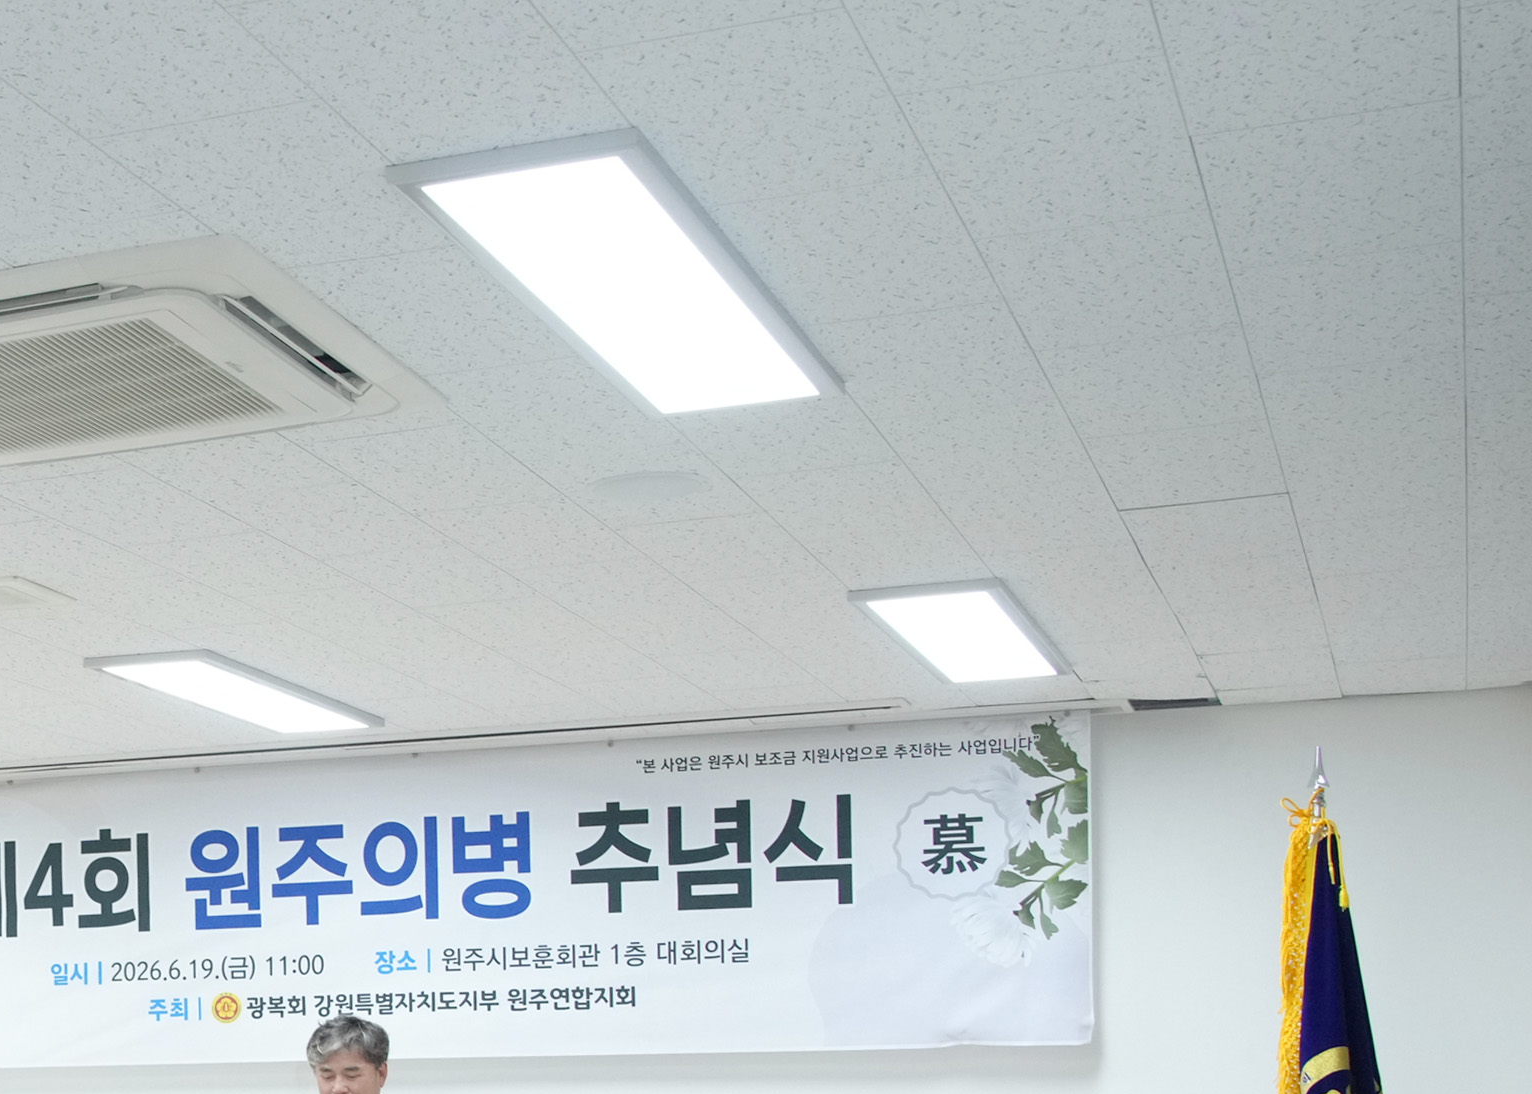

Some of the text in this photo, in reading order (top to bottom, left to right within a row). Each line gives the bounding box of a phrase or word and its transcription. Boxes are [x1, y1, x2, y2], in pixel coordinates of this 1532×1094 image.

[660, 755, 703, 773] 사업은
[707, 752, 749, 770] 원주시
[754, 750, 797, 766] 보조금
[801, 745, 889, 764] 지원사업으로
[893, 741, 953, 759] 추진하는
[184, 810, 532, 931] 원주의병
[570, 793, 854, 914] 추념식
[921, 813, 988, 876] 慕
[50, 937, 750, 987] 일시 2026.6.19.(금) 11:00 장소 원주시보훈회관 1층 대회의실
[147, 985, 637, 1022] 주최 광복회 강원특별자치도지부 원주연합지회
